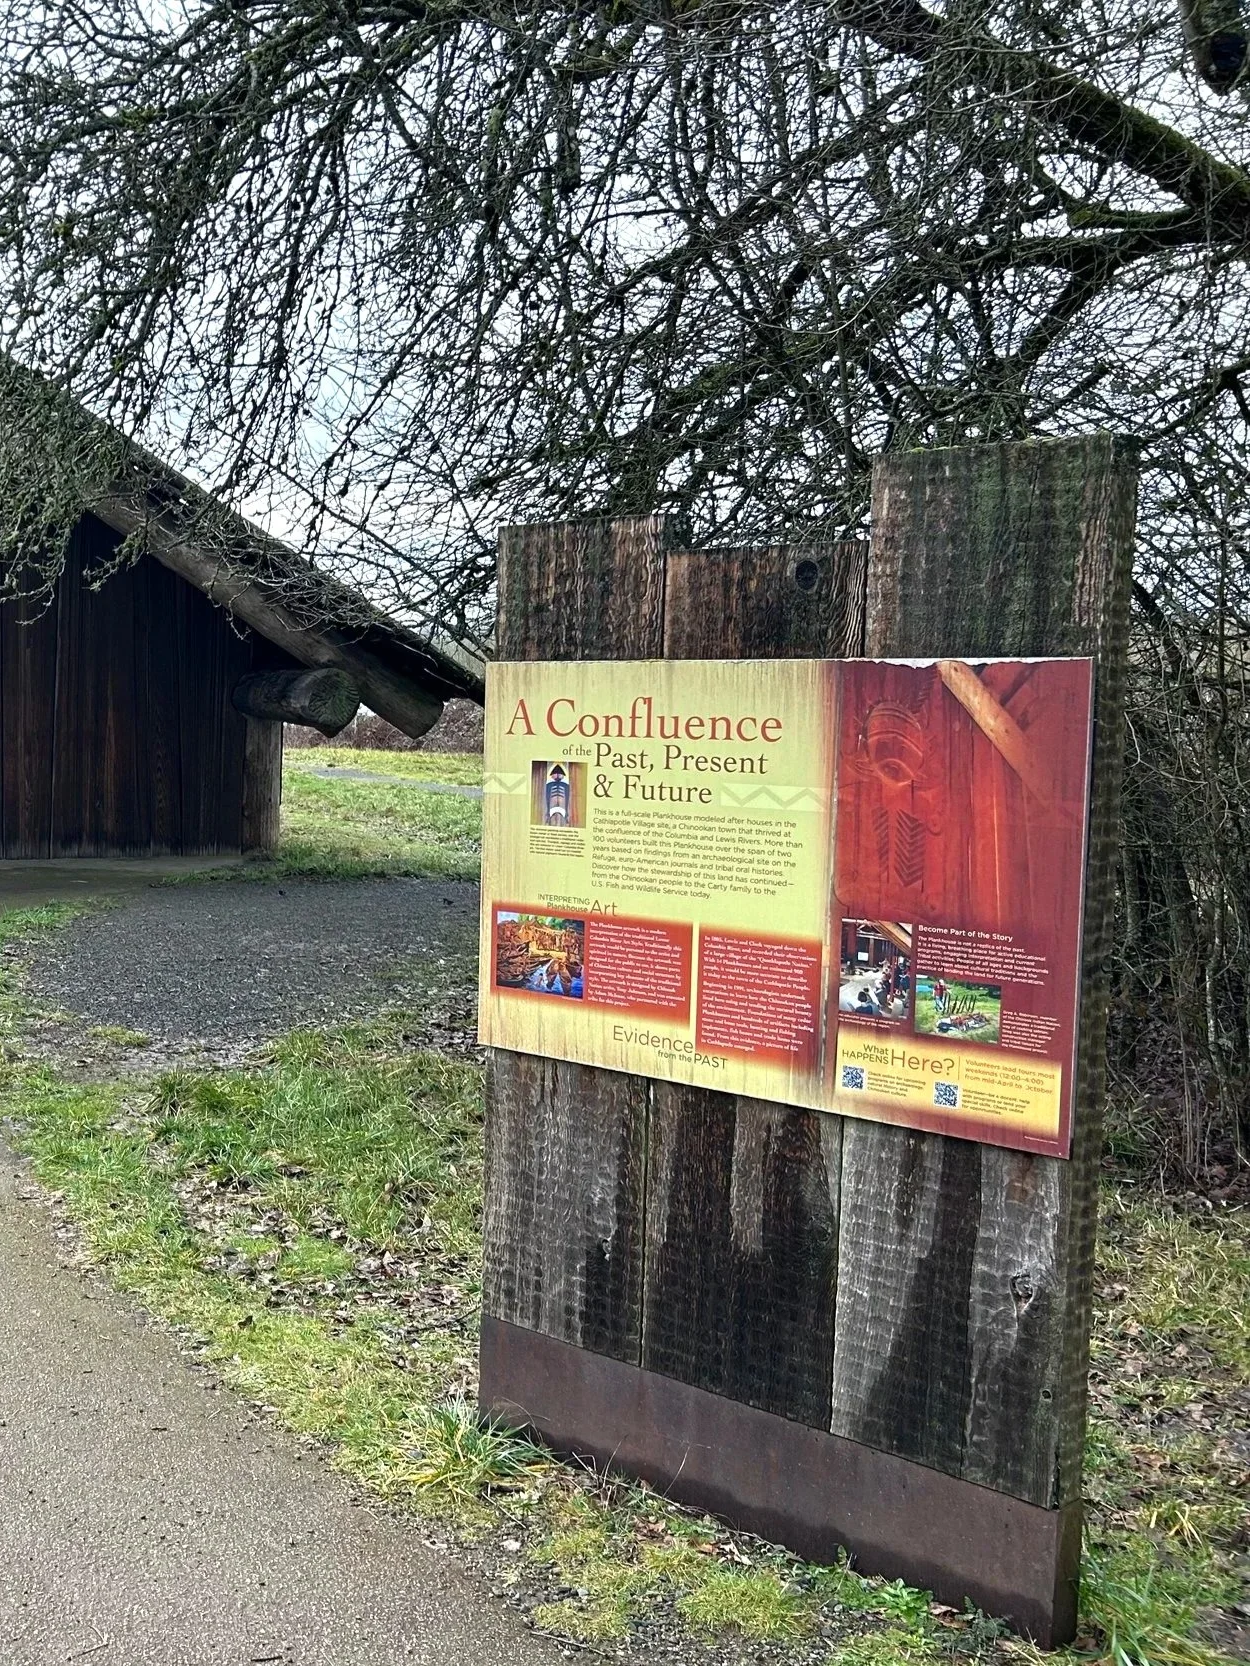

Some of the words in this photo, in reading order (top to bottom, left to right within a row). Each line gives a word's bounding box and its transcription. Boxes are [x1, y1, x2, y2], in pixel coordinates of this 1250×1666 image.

[506, 698, 536, 736] A
[546, 696, 783, 742] Confluence
[562, 745, 574, 756] of
[575, 746, 592, 756] the
[594, 743, 654, 773] Past,
[664, 745, 769, 775] Present
[593, 774, 613, 798] &
[623, 775, 712, 804] Future
[621, 810, 651, 818] full-scale
[653, 812, 692, 820] Plankhouse
[747, 818, 773, 826] houses
[605, 828, 641, 836] confluence
[665, 832, 698, 840] Columbia
[738, 837, 762, 845] Rivers.
[632, 820, 655, 828] Village
[678, 823, 716, 831] Chinookan
[755, 829, 781, 837] thrived
[674, 842, 713, 851] Plankhouse
[592, 854, 616, 862] Refuge,
[644, 849, 671, 857] findings
[702, 855, 754, 864] archaeological
[651, 869, 692, 877] stewardship
[622, 874, 657, 883] Chinookan
[708, 883, 727, 891] Carty
[730, 885, 752, 894] family
[764, 888, 776, 896] the
[636, 885, 661, 893] Wildlife
[663, 888, 688, 896] Service
[690, 891, 711, 899] today.
[538, 894, 590, 905] INTERPRETING
[547, 902, 588, 913] Plankhouse
[590, 900, 618, 916] Art
[919, 925, 948, 934] Become
[992, 934, 1013, 942] Story
[613, 1025, 693, 1053] Evidence
[863, 1044, 889, 1055] What
[658, 1050, 676, 1060] from
[678, 1052, 692, 1062] the
[694, 1053, 728, 1069] PAST
[842, 1049, 889, 1065] HAPPENS
[891, 1048, 954, 1076] Here?
[966, 1060, 1000, 1069] Volunteers
[965, 1068, 998, 1077] weekends
